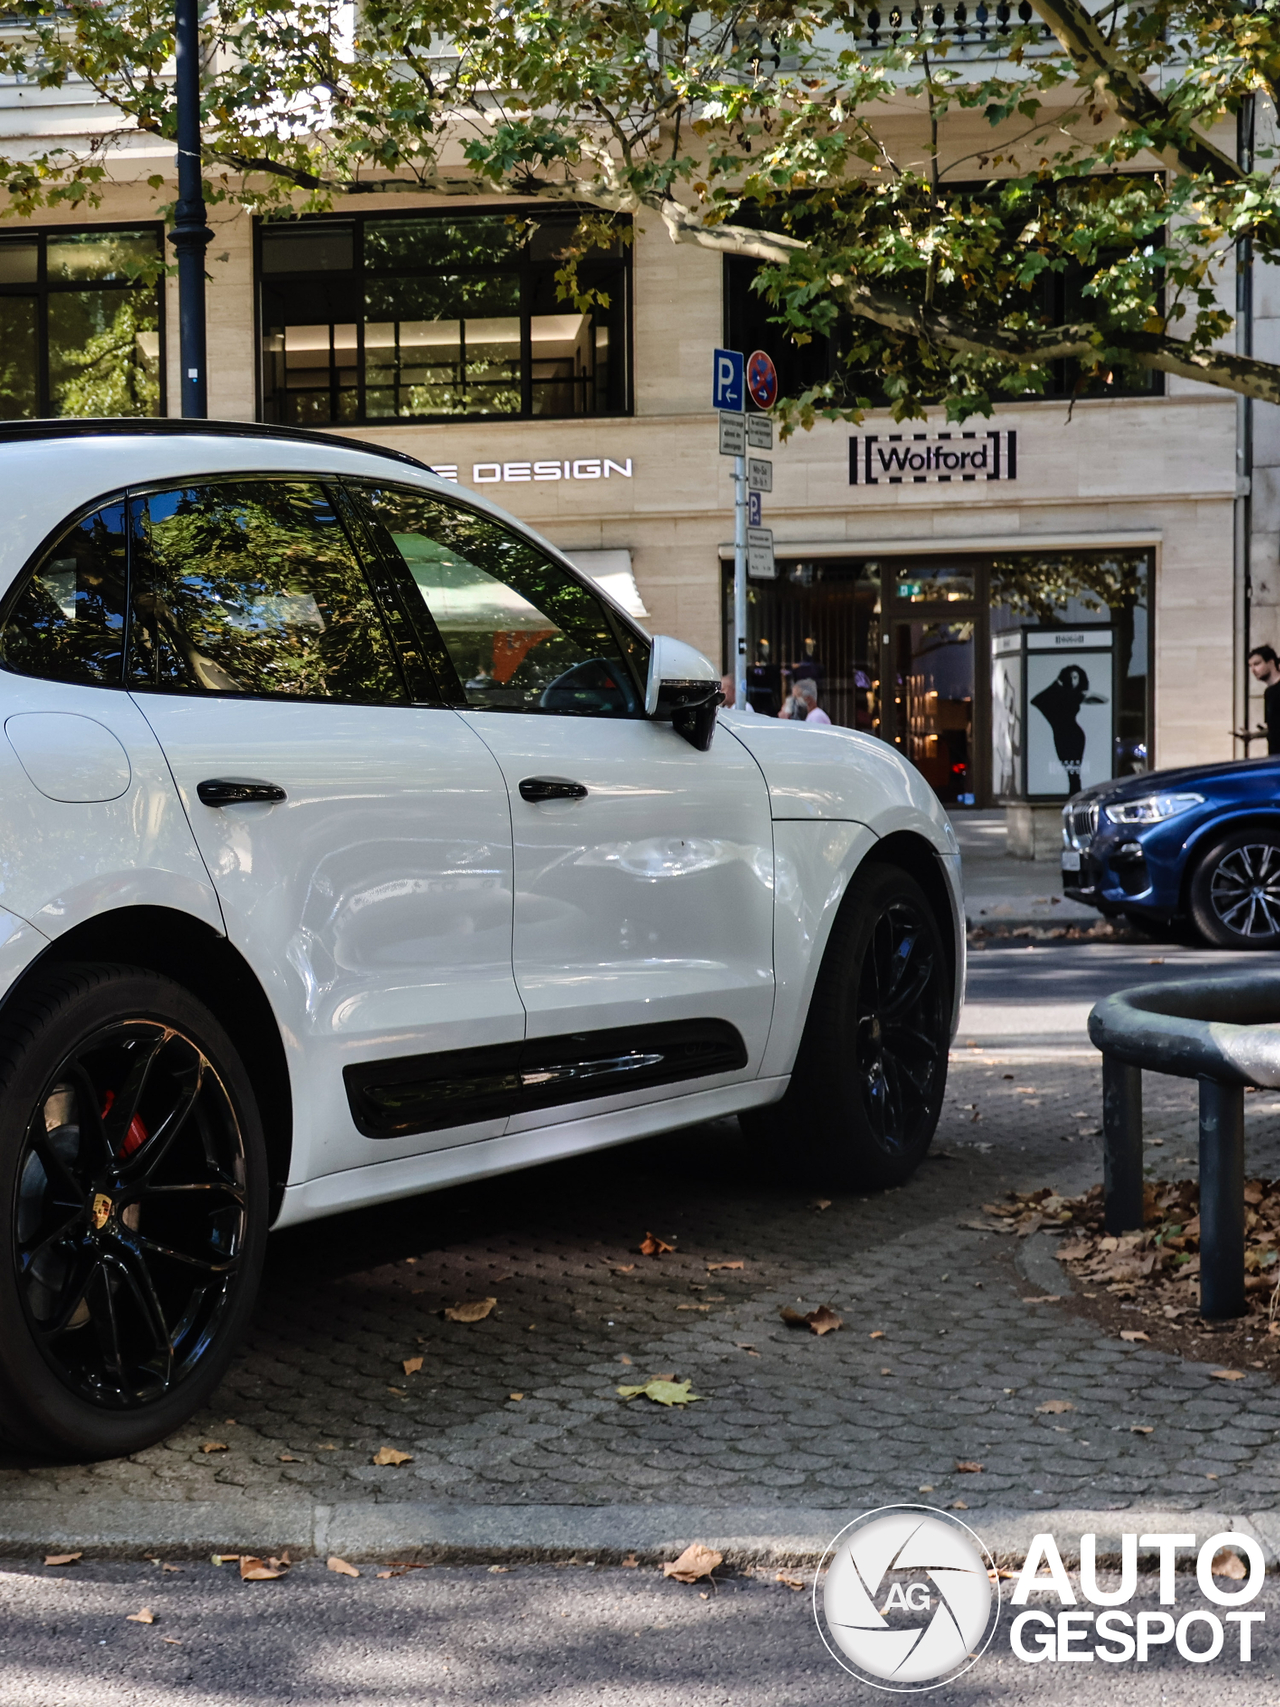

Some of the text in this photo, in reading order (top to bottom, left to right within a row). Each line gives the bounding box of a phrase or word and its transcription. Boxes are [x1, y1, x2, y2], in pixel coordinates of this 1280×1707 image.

[718, 357, 734, 401] P
[473, 458, 632, 484] DESIGN
[877, 444, 988, 472] Wolford
